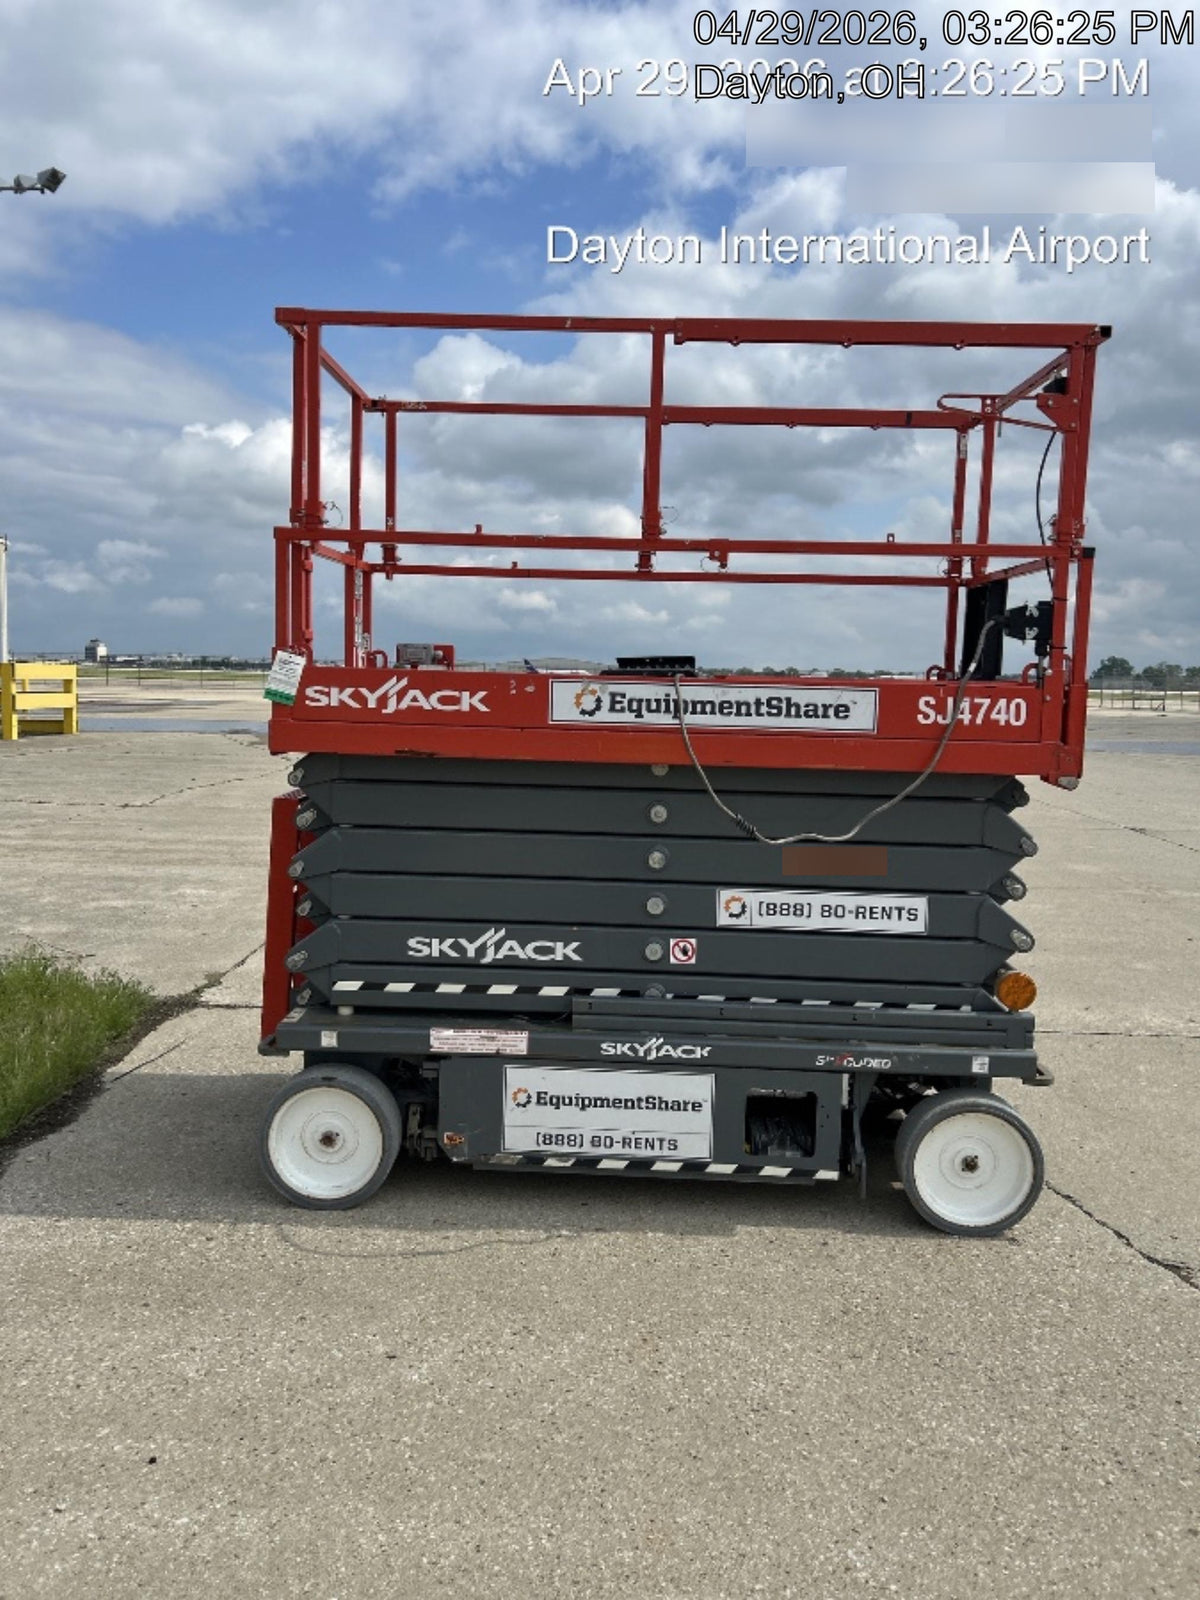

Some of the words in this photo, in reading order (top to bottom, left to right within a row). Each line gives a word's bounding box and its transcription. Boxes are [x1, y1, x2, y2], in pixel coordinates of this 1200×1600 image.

[305, 675, 491, 714] SKYJACK
[607, 691, 851, 720] EquipmentShare
[917, 696, 1027, 726] SJ4740
[820, 903, 919, 922] 80-RENTS
[406, 927, 584, 964] SKYJACK
[600, 1036, 712, 1060] SKYJACK
[535, 1090, 704, 1113] EquipmentShare
